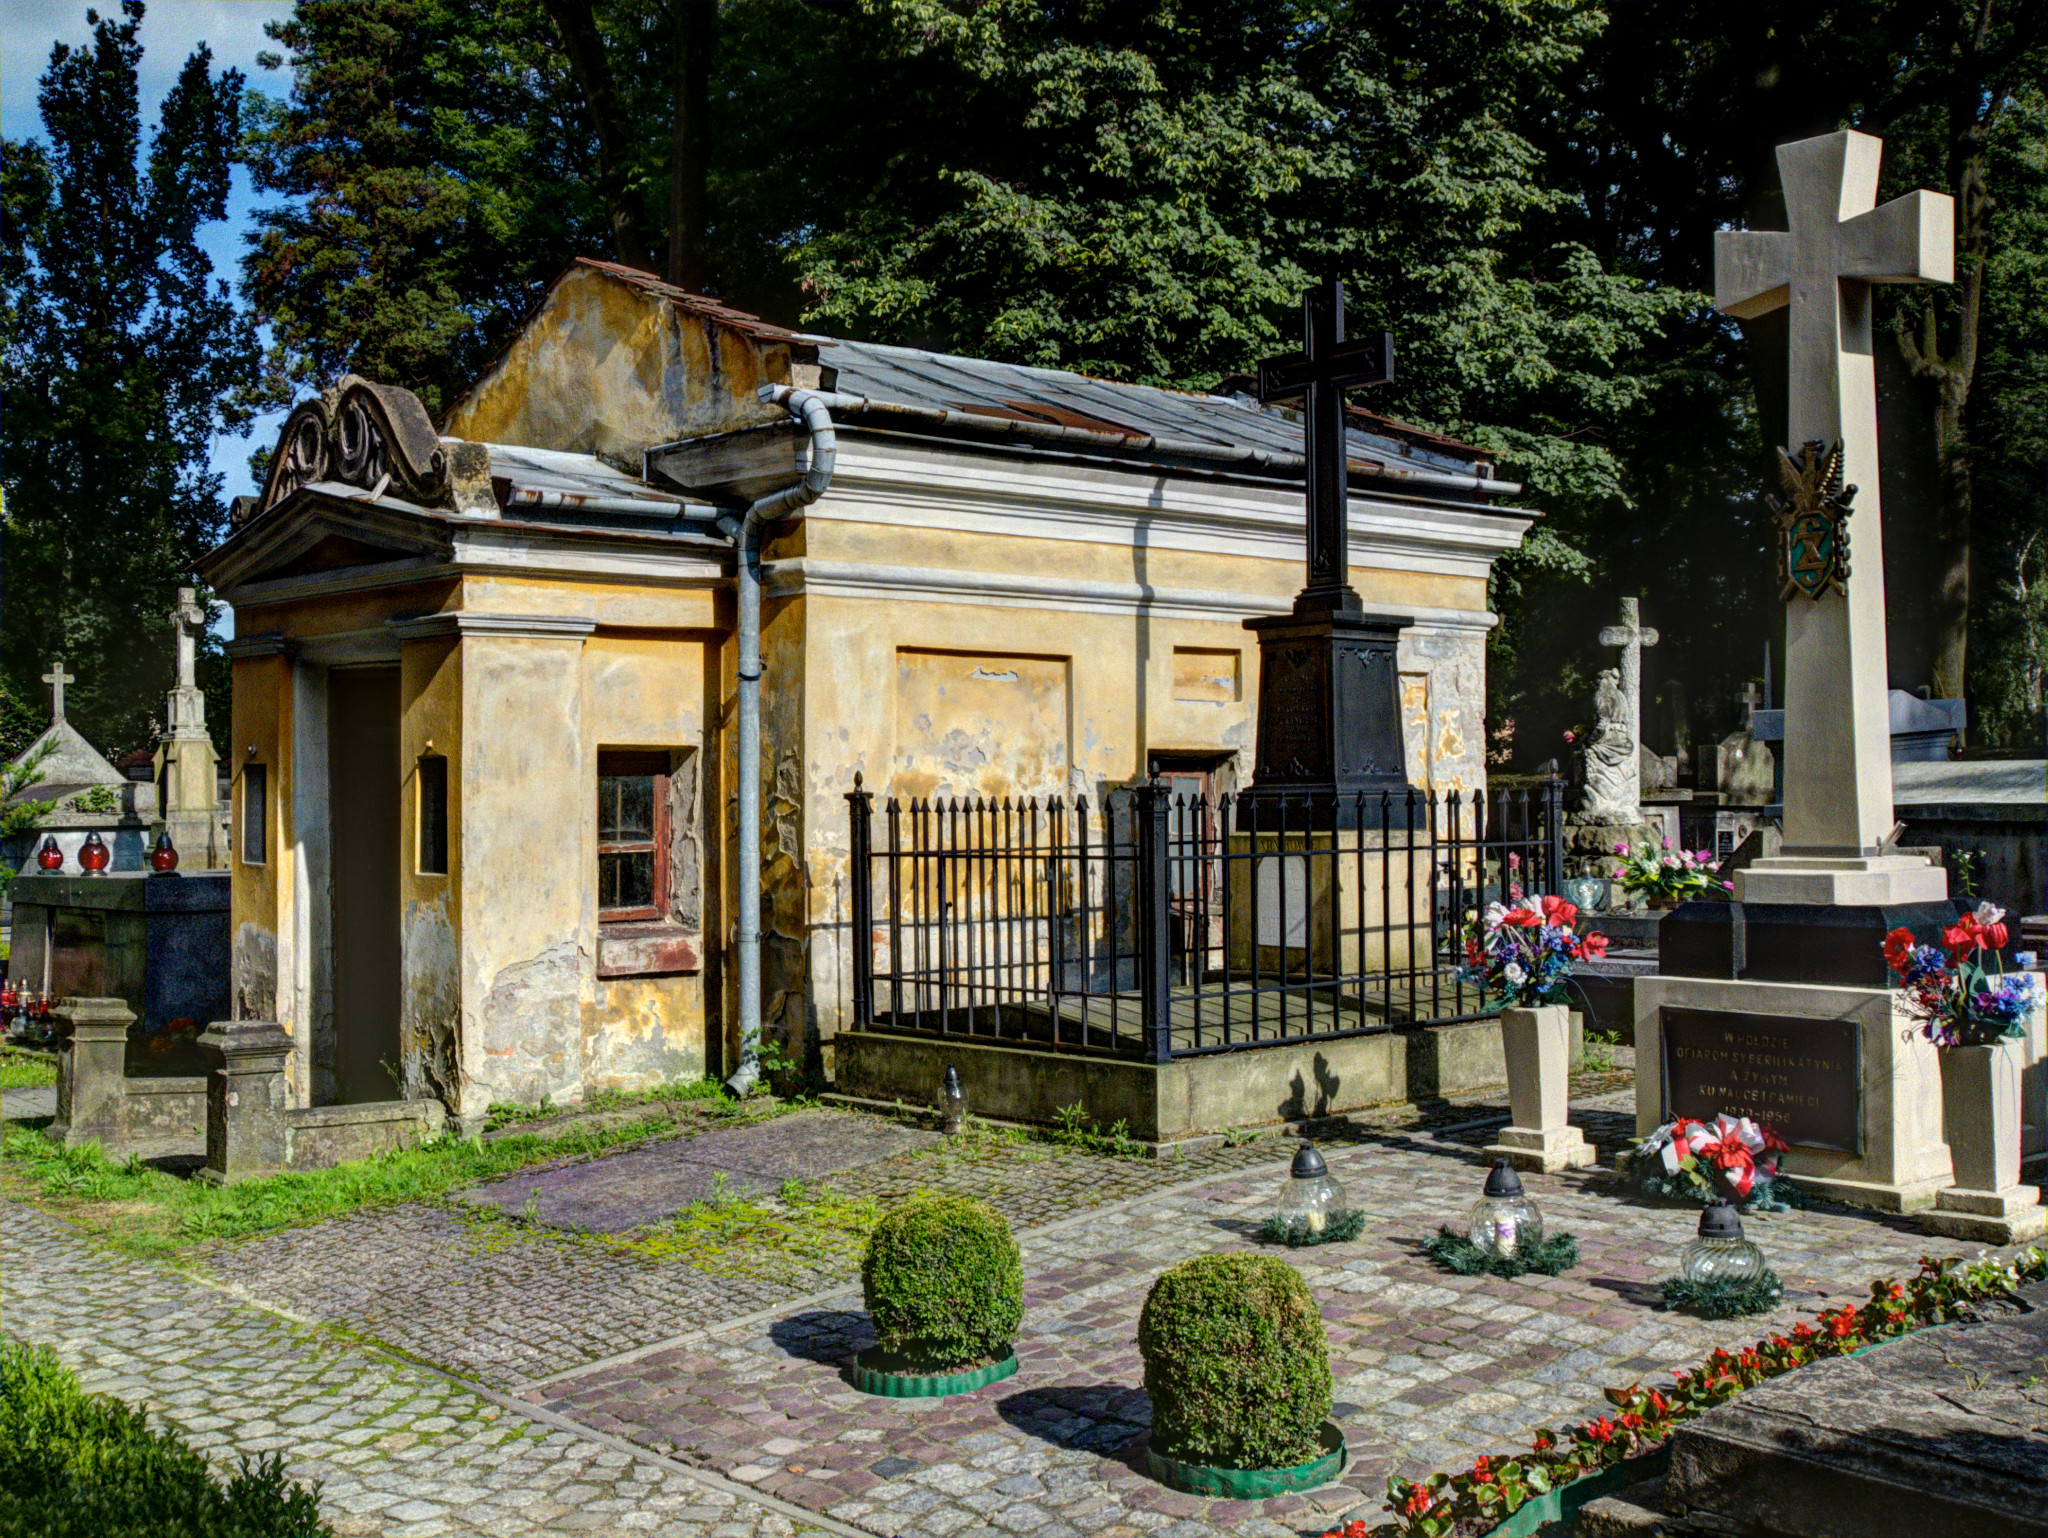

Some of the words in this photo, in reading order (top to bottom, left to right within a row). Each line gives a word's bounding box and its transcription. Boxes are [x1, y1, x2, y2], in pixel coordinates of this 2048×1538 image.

[1724, 1031, 1734, 1044] W
[1676, 1046, 1729, 1062] OFIAROM
[1730, 1069, 1738, 1081] A
[1698, 1084, 1716, 1097] KU
[1719, 1085, 1760, 1102] NAUCE
